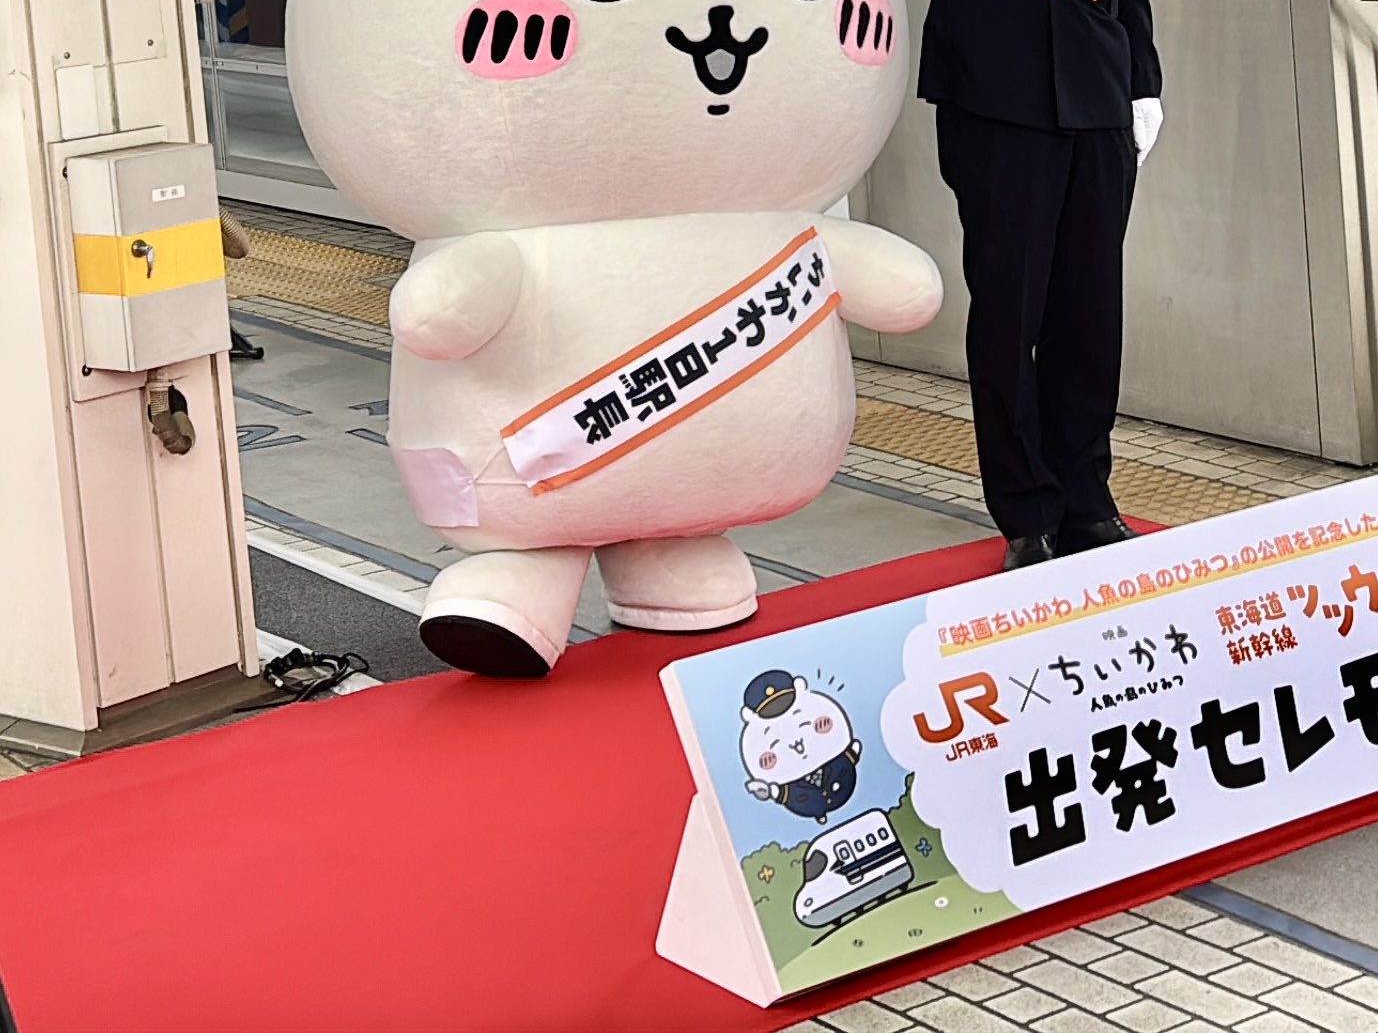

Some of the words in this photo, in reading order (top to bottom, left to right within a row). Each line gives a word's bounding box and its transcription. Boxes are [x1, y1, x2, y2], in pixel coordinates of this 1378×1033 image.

[573, 251, 826, 445] ちいかわ1日駅長
[938, 596, 1073, 646] 『映画ちいかわ
[1215, 591, 1287, 636] 東海道
[1226, 624, 1299, 665] 新幹線
[912, 671, 1010, 743] JR
[1048, 624, 1198, 696] ちいかわ
[945, 732, 999, 762] JR東海
